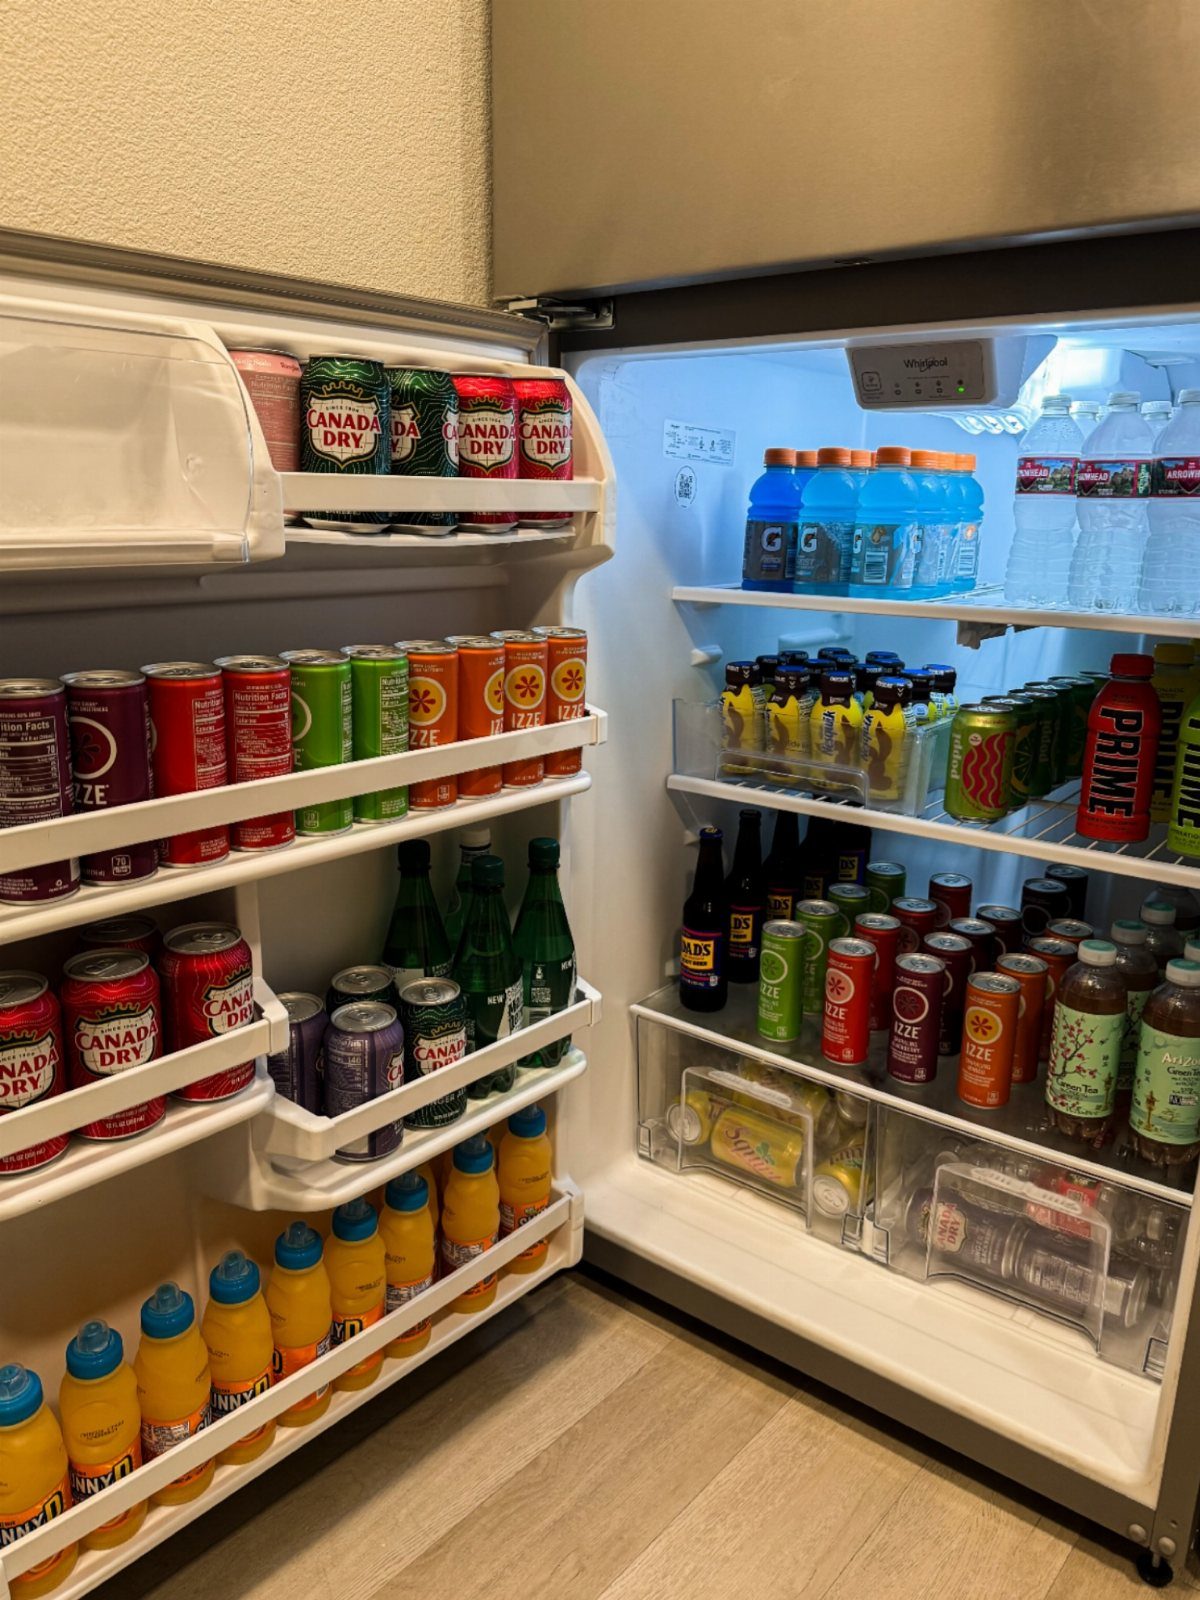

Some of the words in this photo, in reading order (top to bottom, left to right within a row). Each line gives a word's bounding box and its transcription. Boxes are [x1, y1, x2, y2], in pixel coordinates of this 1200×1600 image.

[903, 357, 948, 373] Whirlpool
[307, 409, 382, 433] CANADA
[459, 421, 516, 440] CANADA
[323, 430, 363, 448] DRY
[470, 440, 504, 455] DRY
[536, 440, 567, 455] DRY
[761, 527, 782, 552] G
[801, 527, 818, 553] G
[853, 528, 862, 554] G
[511, 711, 542, 729] IZZE
[557, 703, 584, 720] IZZE
[0, 722, 23, 732] ition
[25, 721, 50, 731] Facts
[410, 729, 441, 746] ZZE
[950, 733, 963, 780] poppi
[1087, 706, 1145, 819] PRIME
[73, 783, 108, 805] ZZE
[115, 856, 127, 866] 70
[203, 985, 253, 1017] CANA
[487, 995, 504, 1005] NEW
[825, 1001, 849, 1020] IZZE
[75, 1019, 159, 1051] CANADA
[894, 1021, 922, 1040] IZZE
[100, 1044, 144, 1067] DRY
[415, 1040, 466, 1060] CANAD
[966, 1042, 995, 1062] IZZE
[1162, 1052, 1200, 1067] AriZo
[0, 1048, 59, 1080] NADA
[1056, 1077, 1082, 1093] Green
[1082, 1084, 1099, 1094] Tea
[724, 1126, 783, 1182] Squirt
